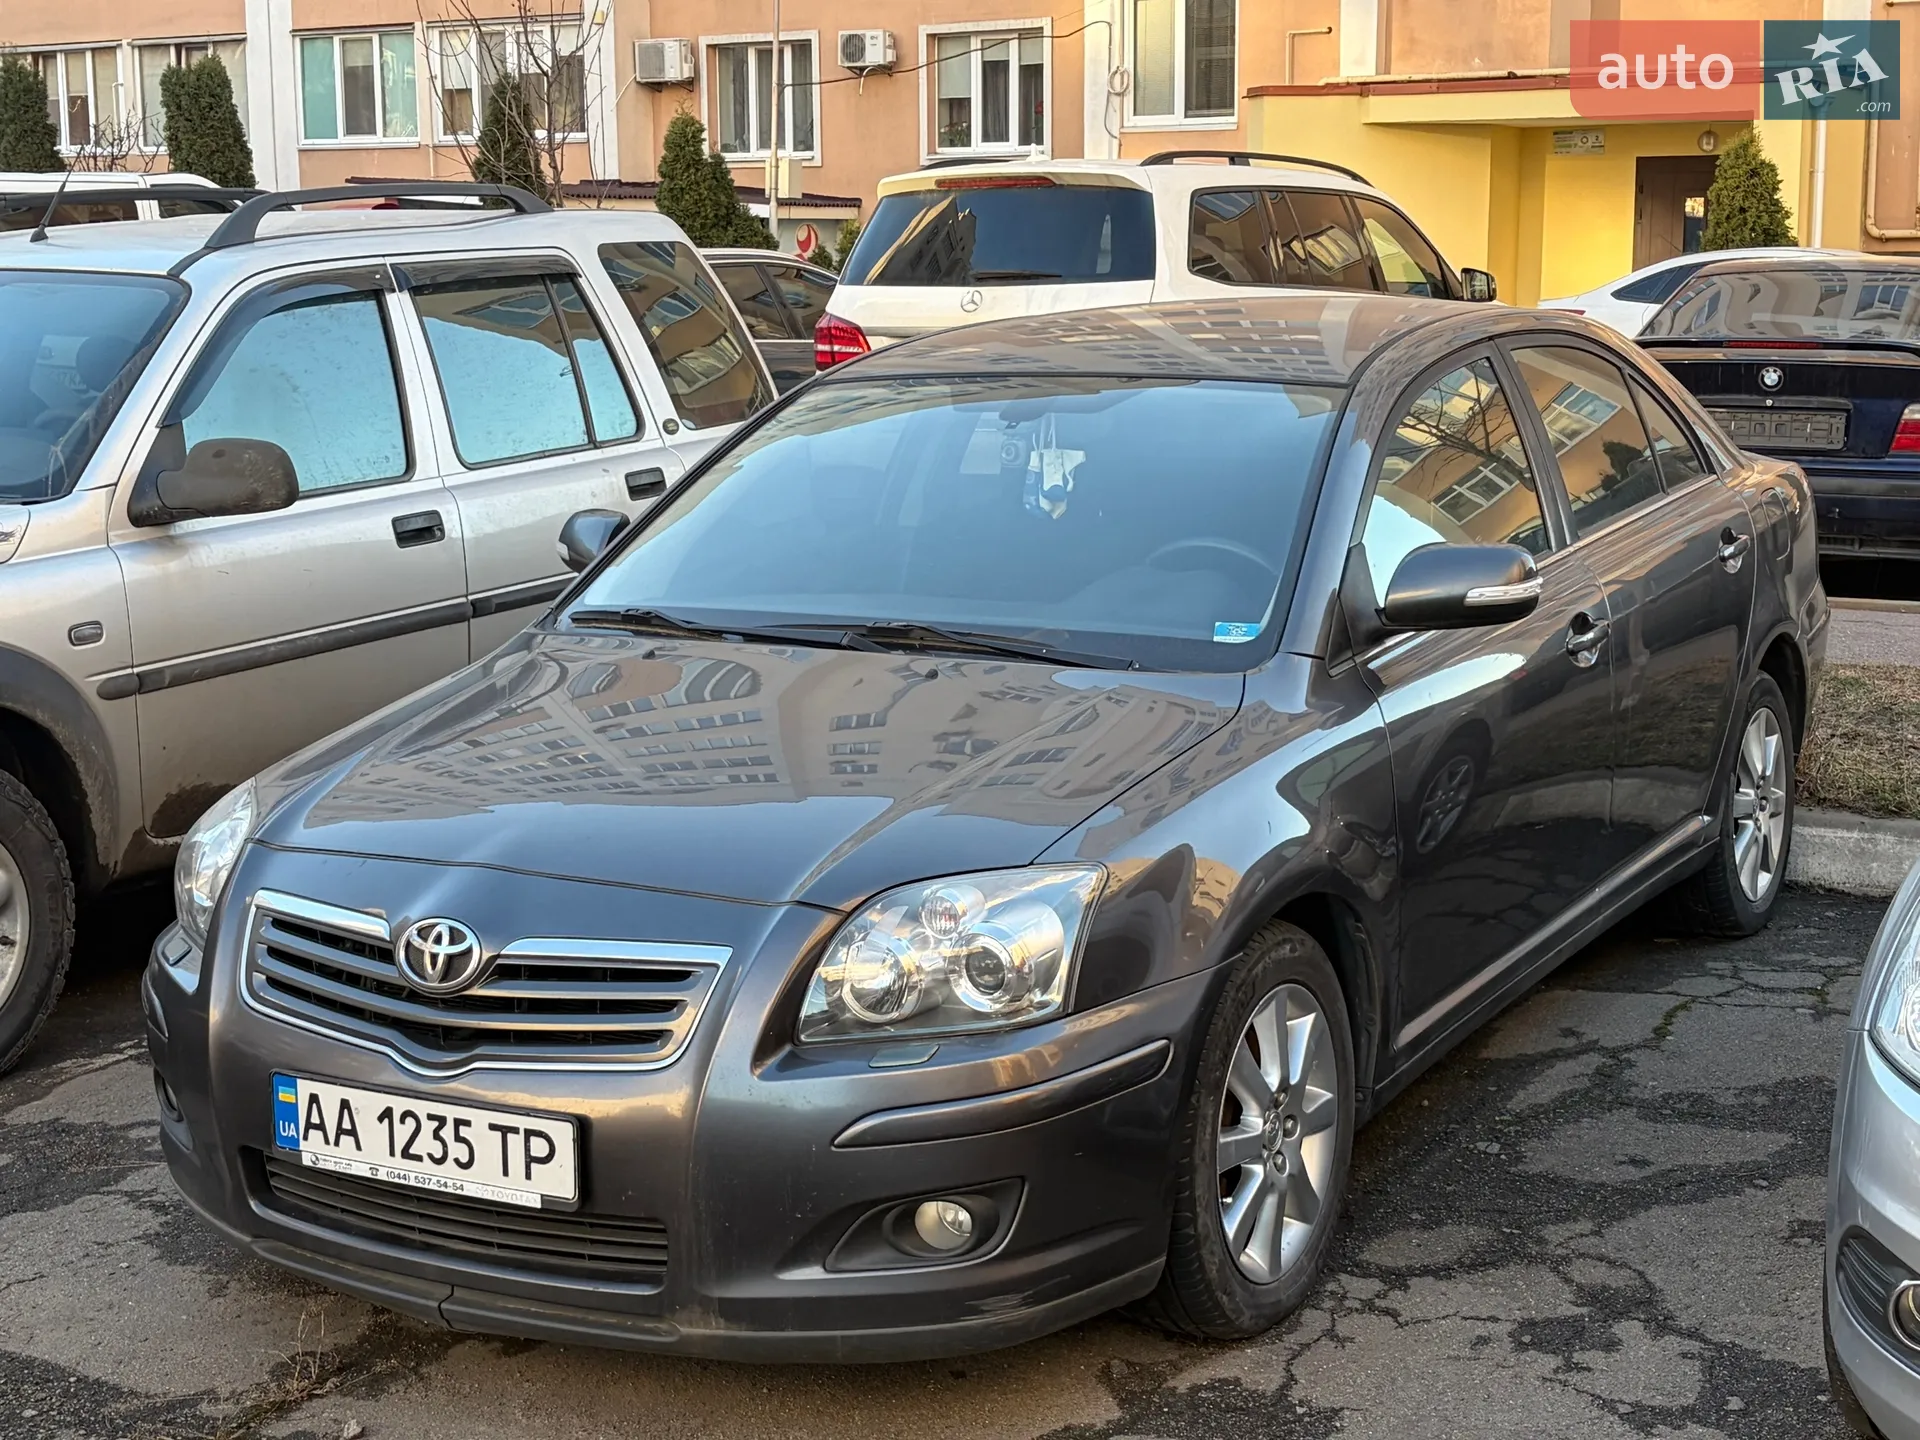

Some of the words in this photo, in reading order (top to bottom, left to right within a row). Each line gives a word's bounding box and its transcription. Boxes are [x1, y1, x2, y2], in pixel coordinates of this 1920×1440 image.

[280, 1121, 297, 1138] UA
[302, 1092, 362, 1151] AA
[377, 1105, 475, 1170] 1235
[488, 1121, 556, 1181] TP
[386, 1170, 411, 1184] (044)
[414, 1175, 465, 1192] 537-54-54
